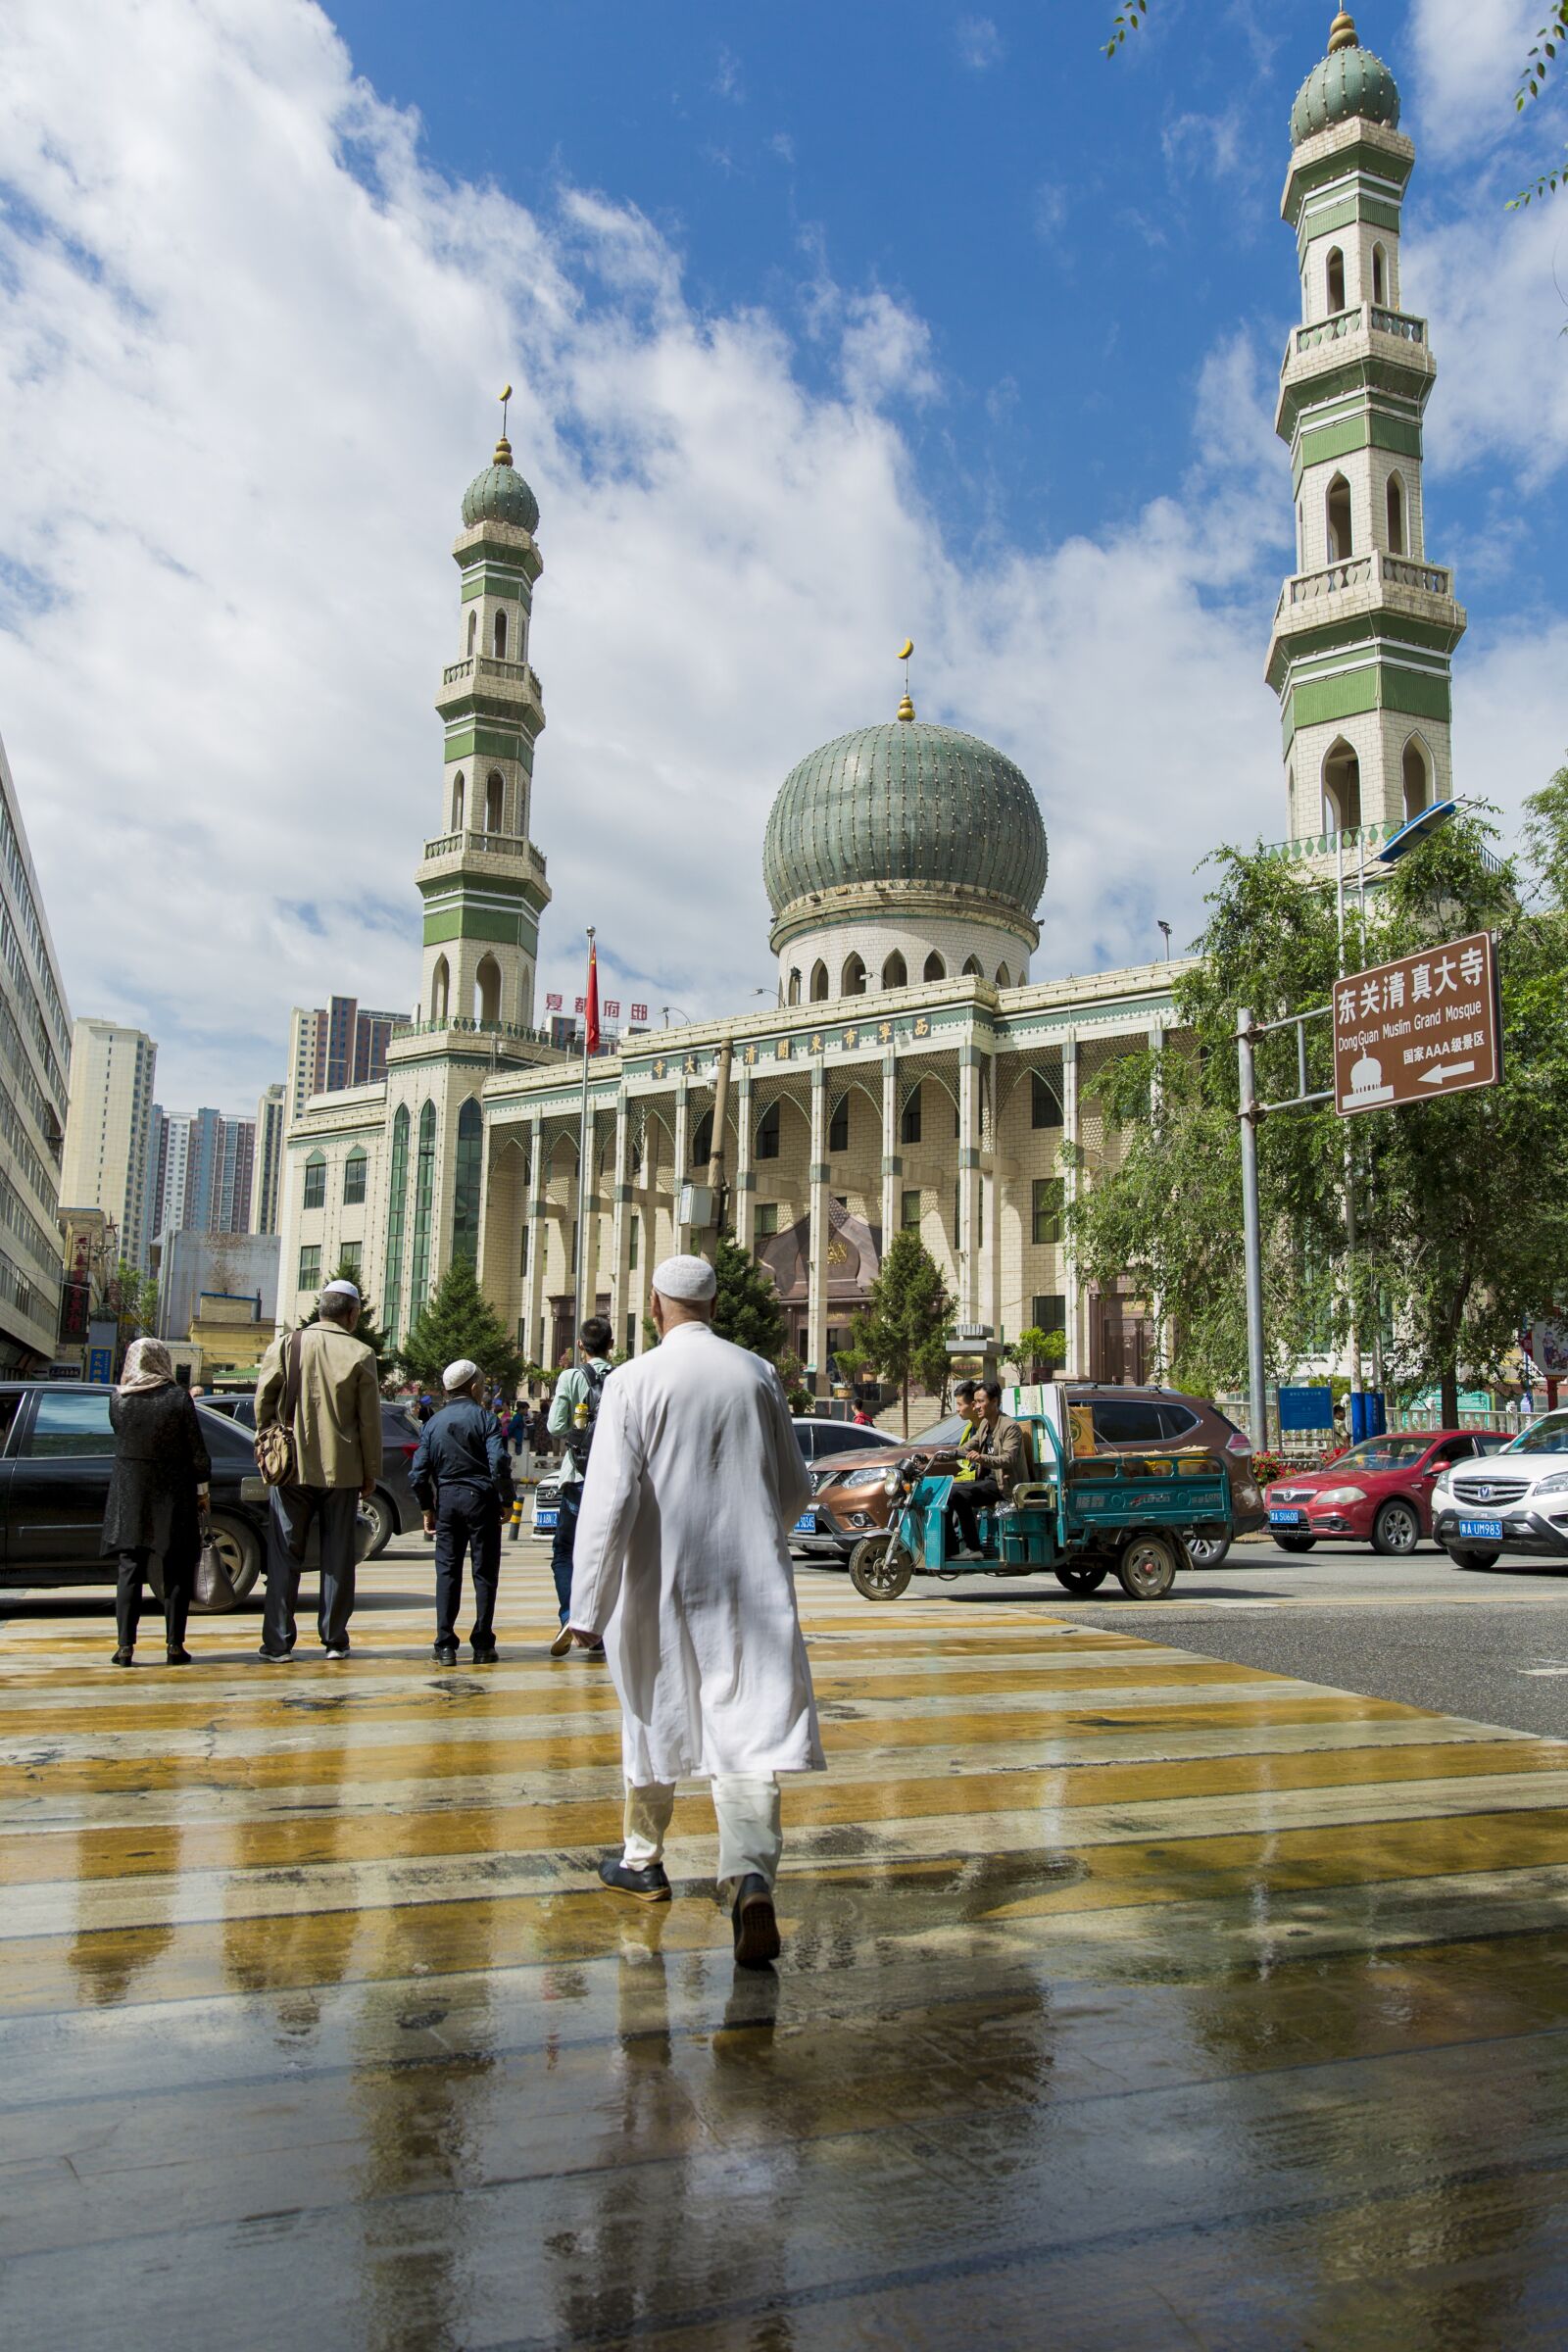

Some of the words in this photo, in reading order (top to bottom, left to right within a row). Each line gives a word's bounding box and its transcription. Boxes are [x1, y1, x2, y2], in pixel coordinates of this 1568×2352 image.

[1338, 947, 1484, 1026] 东关清真大寺
[1383, 1021, 1411, 1040] Muslim
[1414, 1009, 1441, 1030] Grand
[1446, 1000, 1482, 1021] Mosque
[1403, 1030, 1485, 1065] 国家AAA级景区
